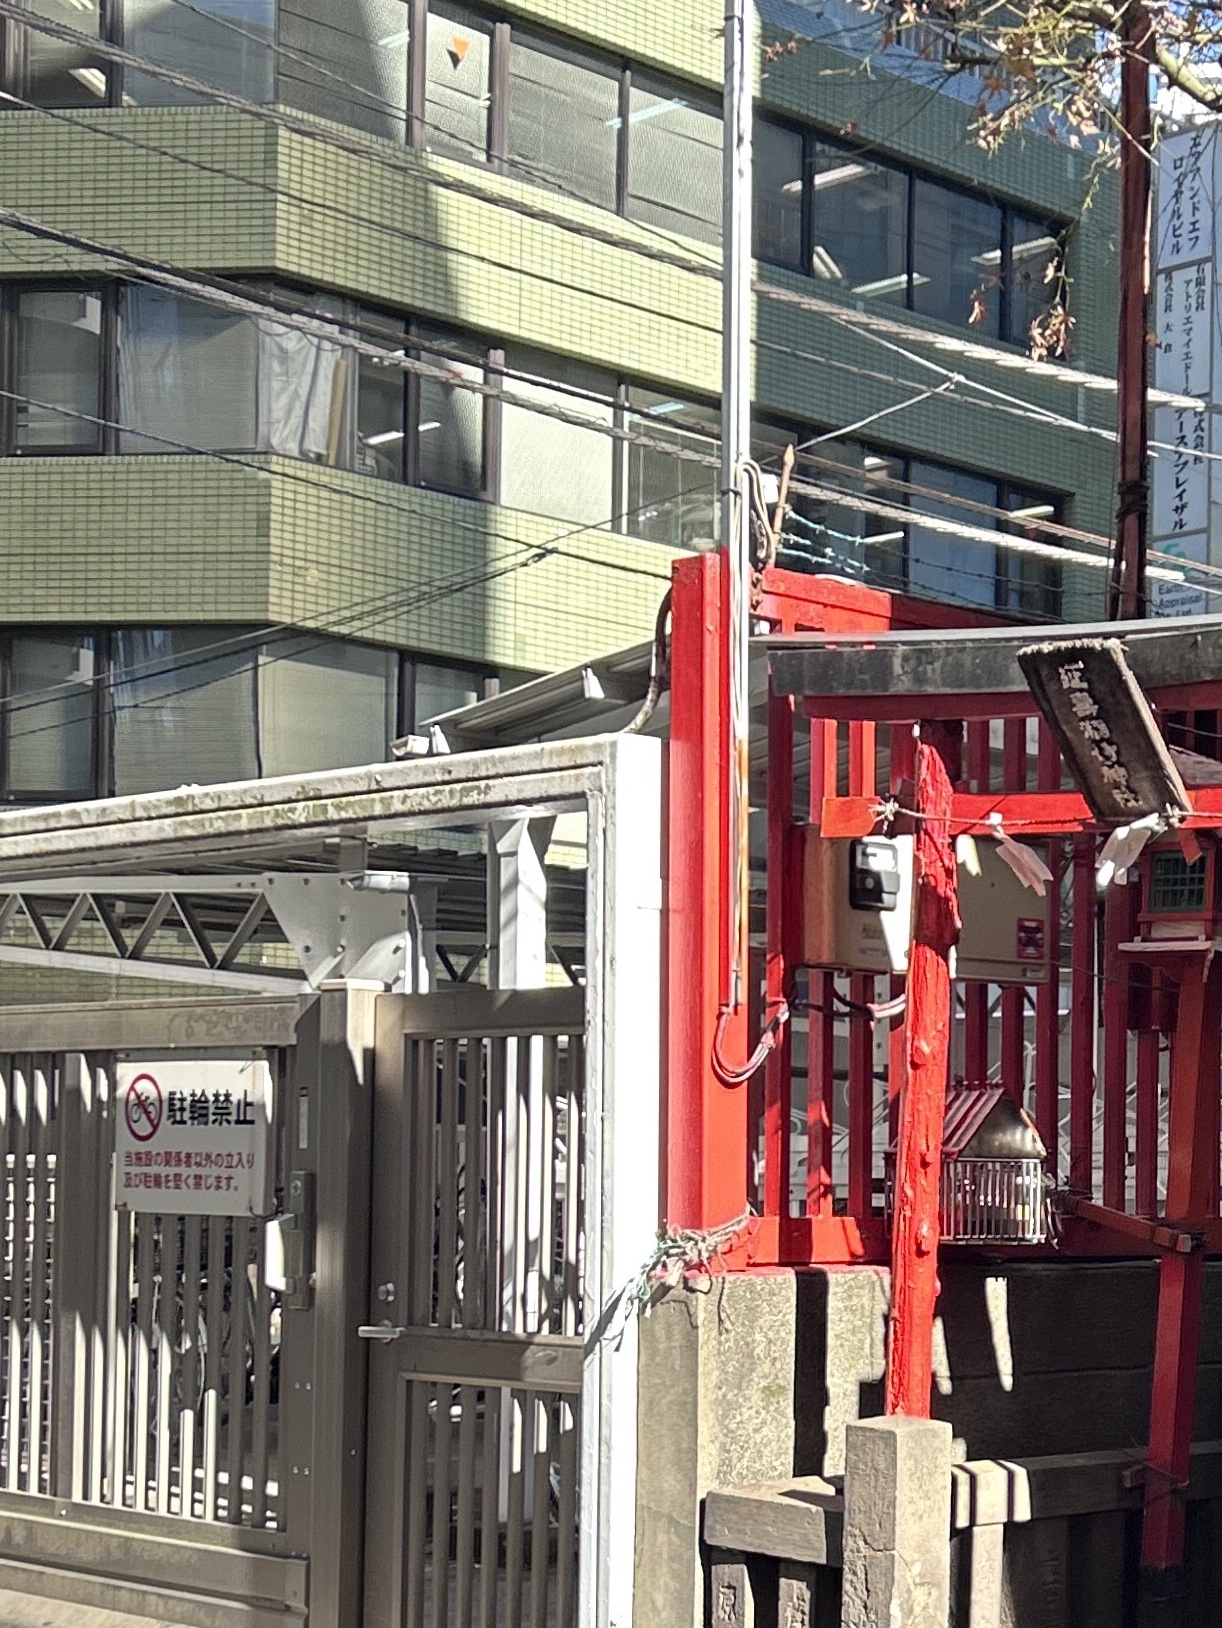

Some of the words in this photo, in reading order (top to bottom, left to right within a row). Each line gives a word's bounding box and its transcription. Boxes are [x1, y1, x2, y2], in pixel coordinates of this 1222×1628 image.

[1170, 156, 1185, 256] ロイヤルビル
[1181, 278, 1194, 397] アトリエマイエドール
[167, 1089, 255, 1126] 駐輪禁止
[124, 1150, 255, 1170] 当施設の関係者以外の立入り
[124, 1172, 239, 1192] 及び駐輪を堅く禁じます。
